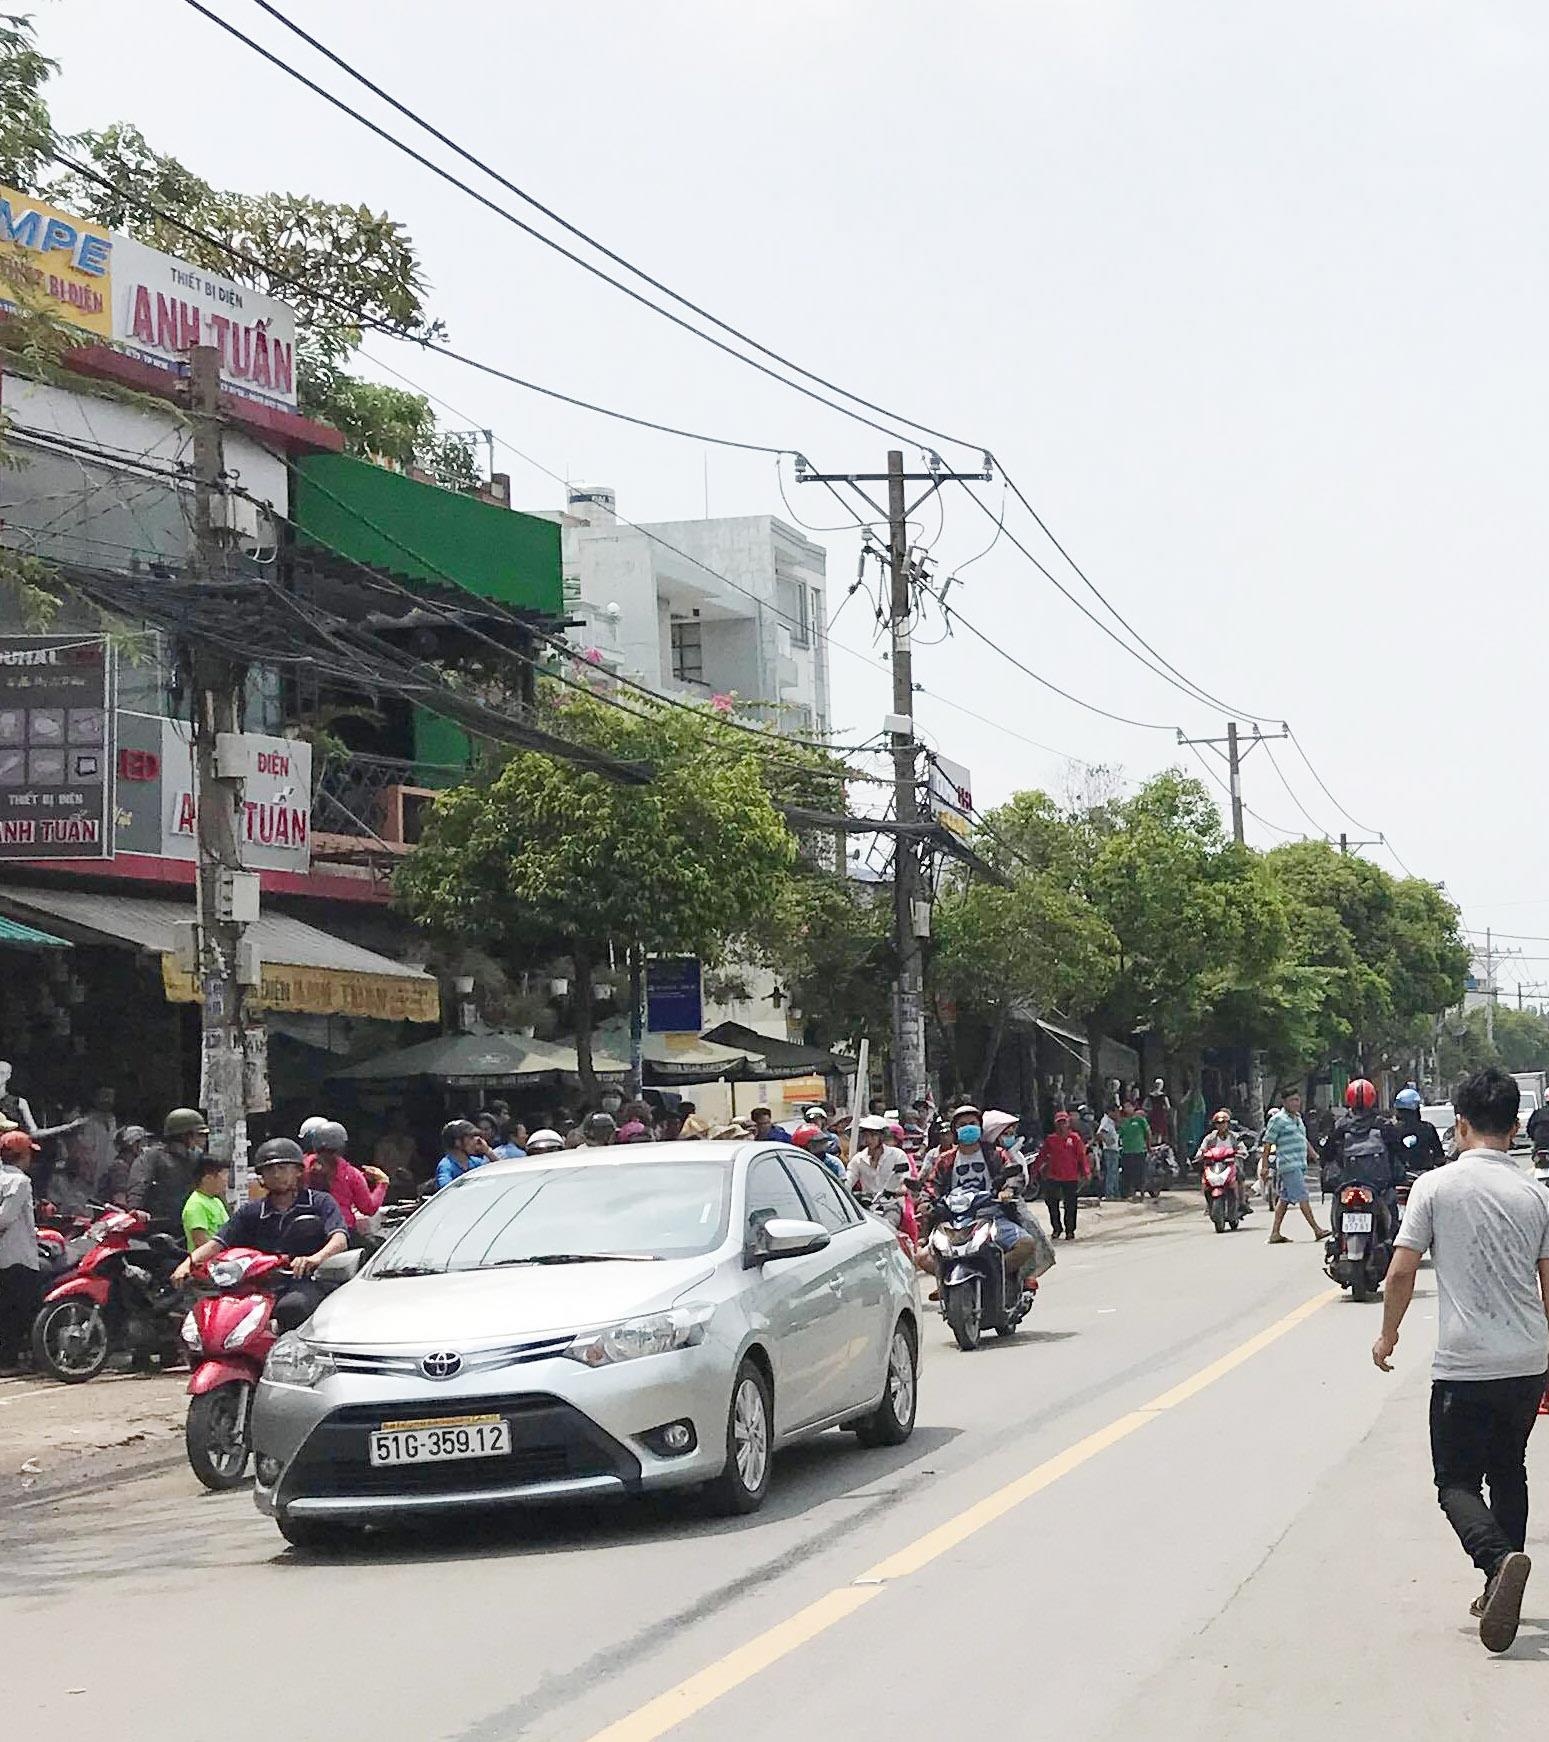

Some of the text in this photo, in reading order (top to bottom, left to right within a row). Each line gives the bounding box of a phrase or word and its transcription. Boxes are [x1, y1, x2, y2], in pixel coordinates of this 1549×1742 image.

[0, 198, 113, 277] MPE
[132, 284, 292, 394] ANH TUẤN
[0, 809, 97, 842] NH TUẤN
[242, 786, 307, 848] TUẤN
[376, 1426, 504, 1461] 51G-359.12
